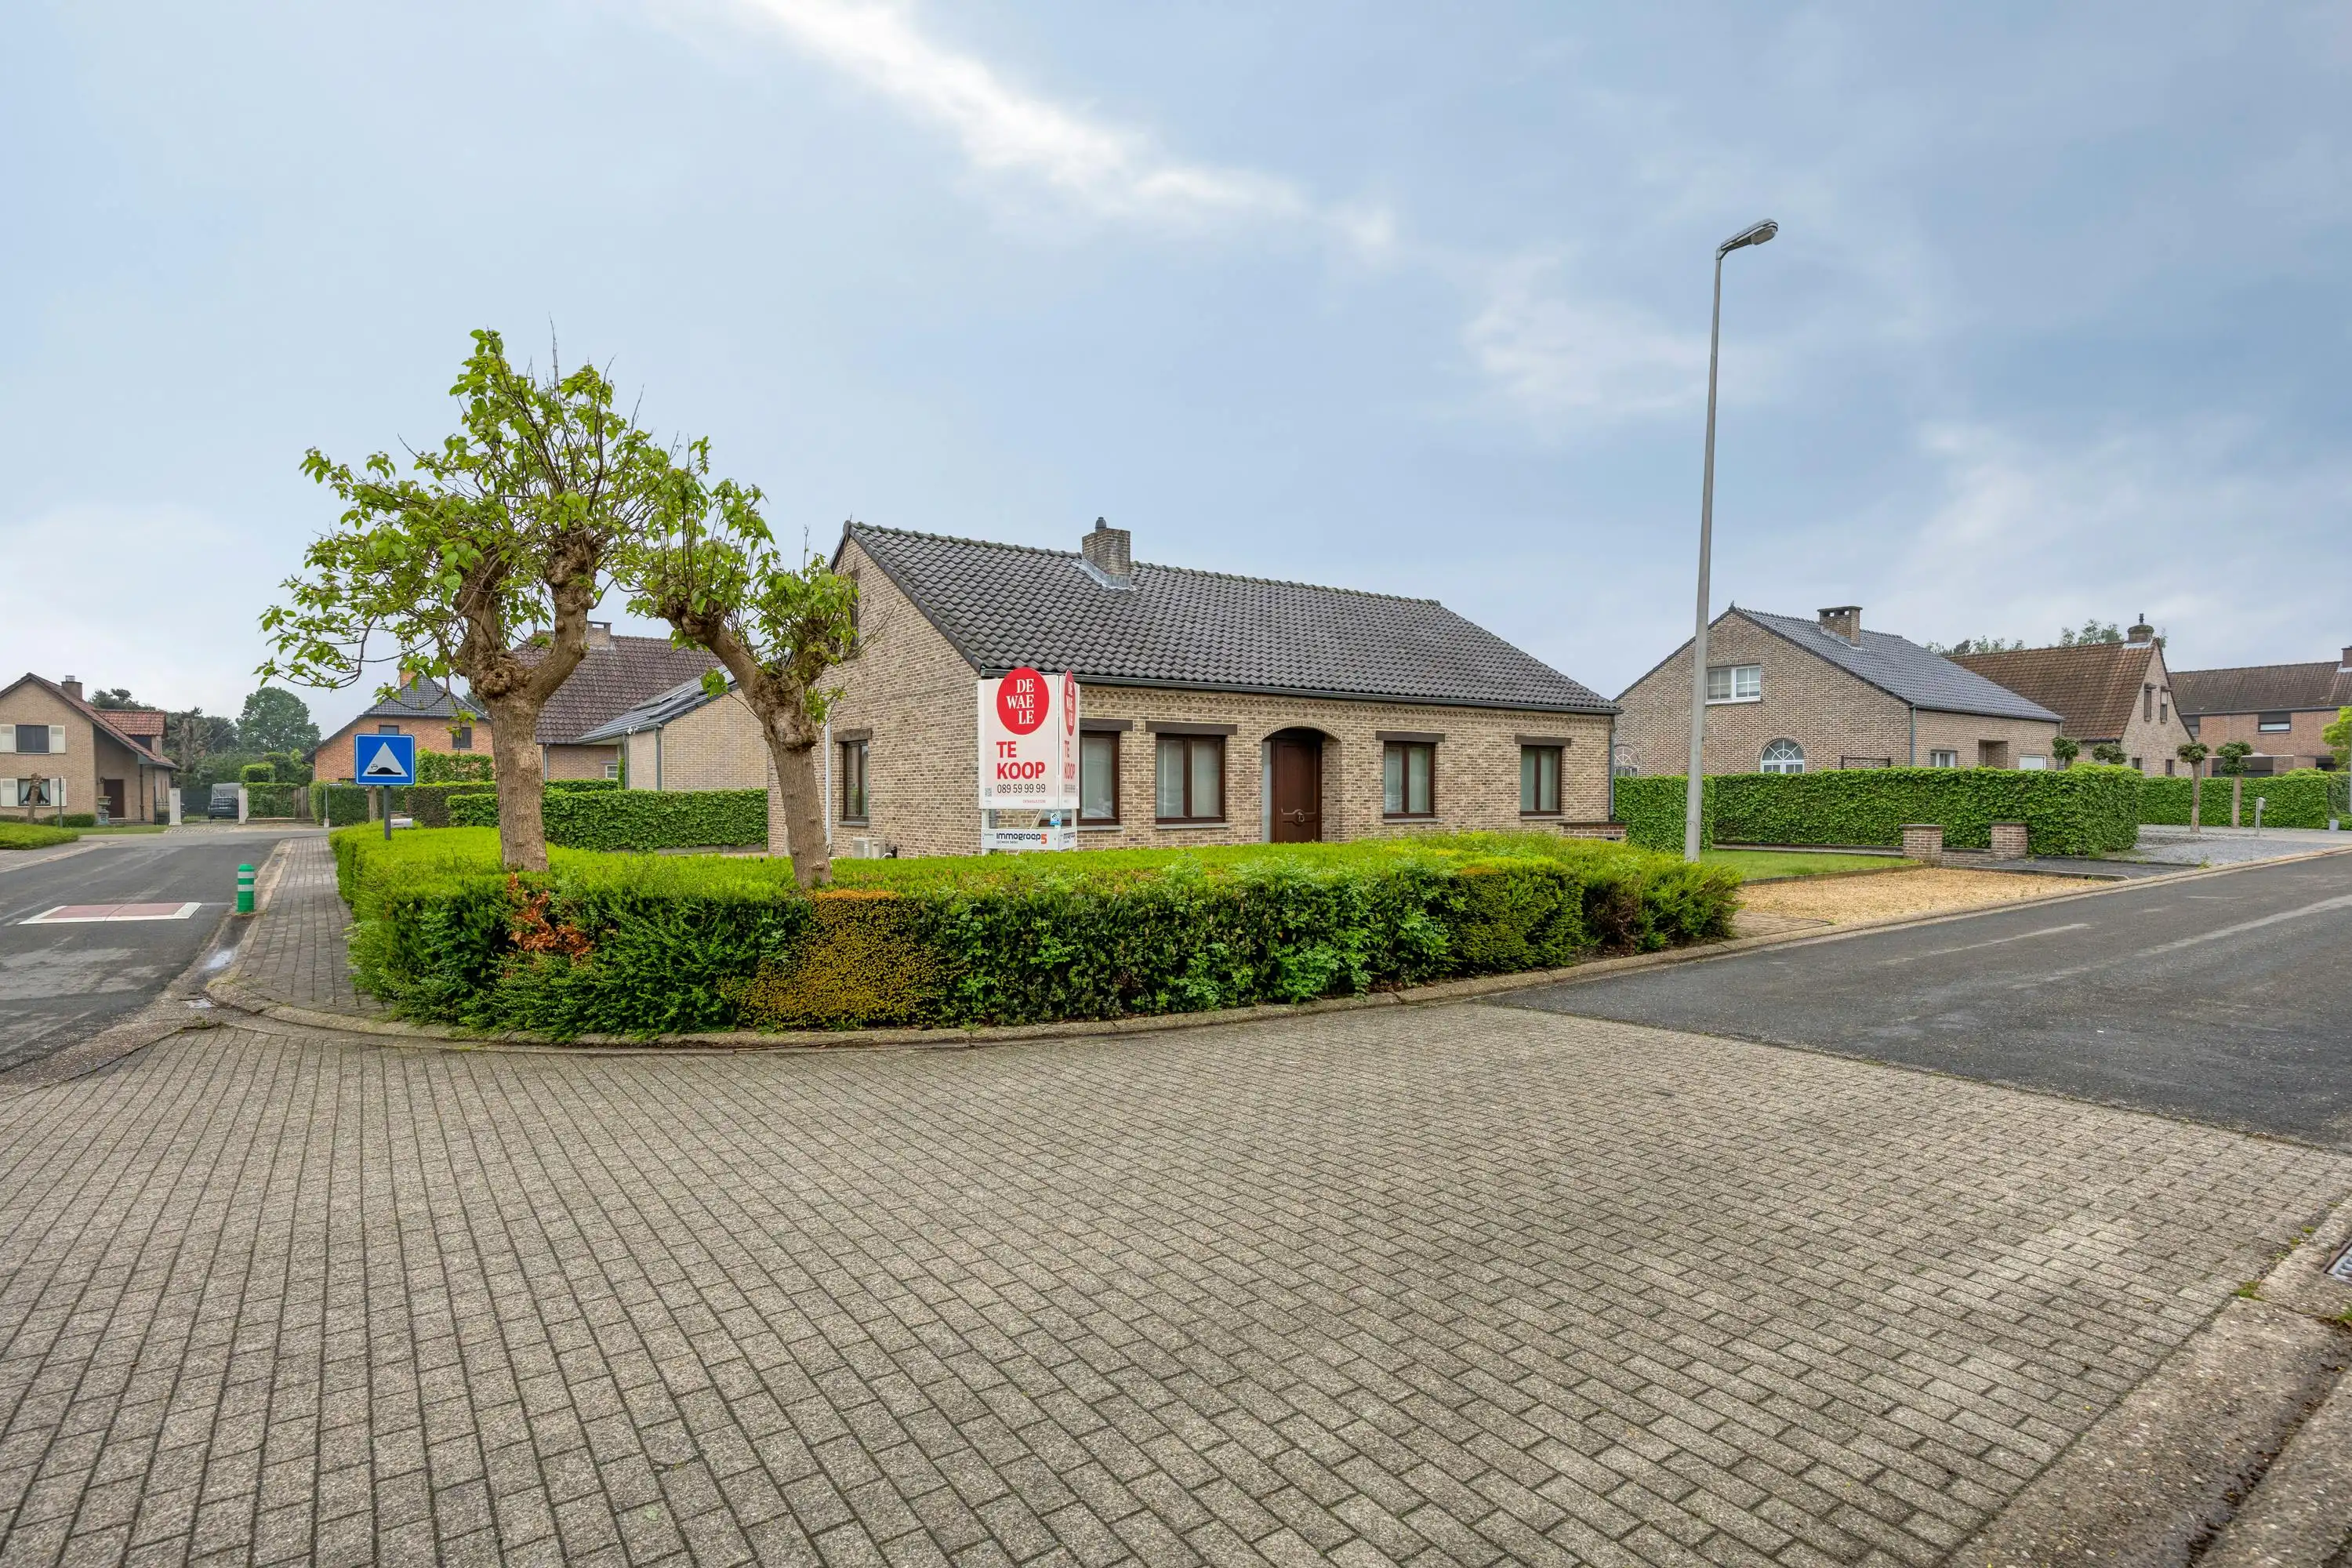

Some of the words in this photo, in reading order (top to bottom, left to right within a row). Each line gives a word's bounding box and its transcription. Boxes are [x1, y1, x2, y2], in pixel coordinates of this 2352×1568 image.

[1016, 679, 1034, 693] DE
[1006, 695, 1035, 710] WAE
[1018, 710, 1034, 724] LE
[996, 741, 1017, 758] TE
[996, 762, 1045, 779] KOOP
[997, 784, 1011, 793] 089
[1013, 784, 1022, 793] 59
[1024, 783, 1034, 793] 99
[1036, 783, 1046, 793] 99
